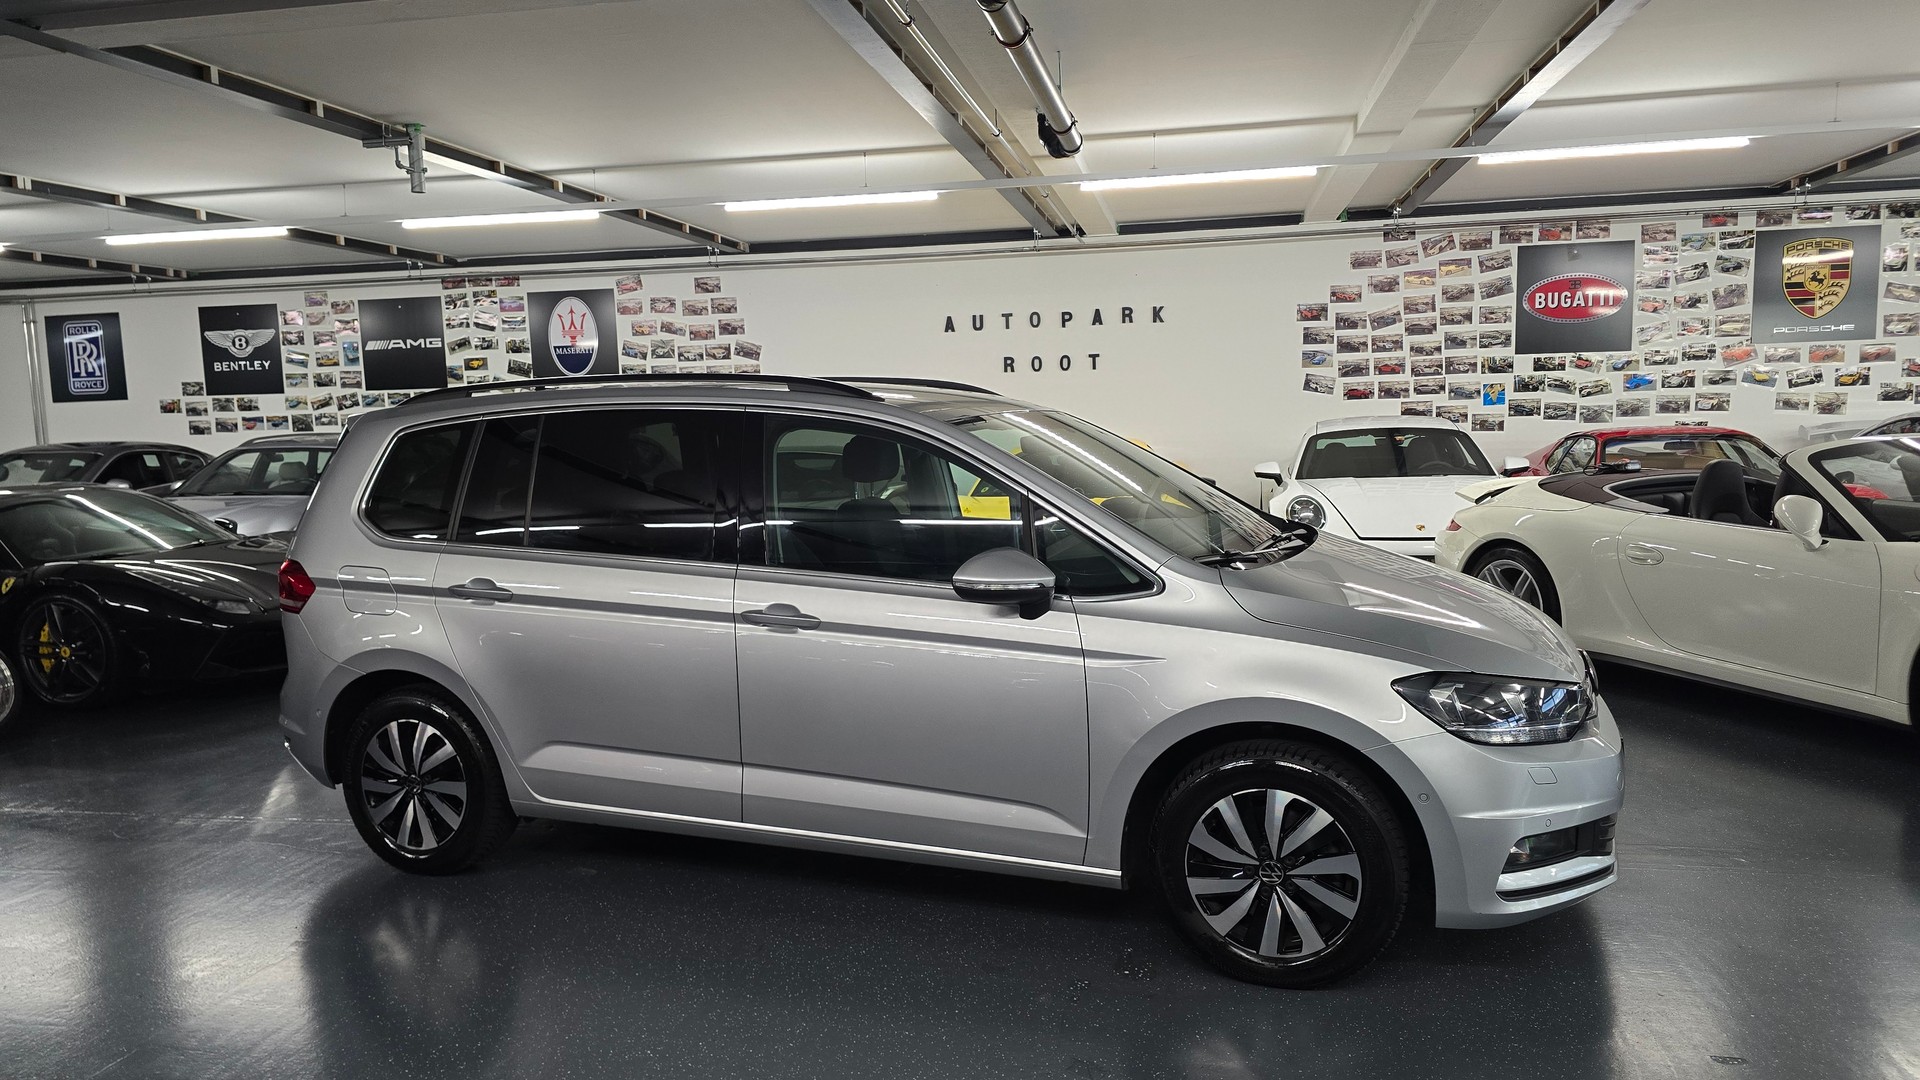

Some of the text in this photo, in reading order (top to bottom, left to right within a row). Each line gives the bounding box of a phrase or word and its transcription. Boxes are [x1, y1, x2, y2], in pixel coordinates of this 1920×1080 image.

[1786, 240, 1850, 255] PORSCHE
[1534, 290, 1615, 309] BUGATTI
[69, 326, 97, 335] ROLLS
[1773, 324, 1855, 334] PORSCHE
[388, 337, 443, 350] AMG
[556, 347, 593, 355] MASERATI
[213, 360, 271, 372] BENTLEY
[1003, 353, 1101, 373] ROOT
[74, 380, 102, 389] ROYCE
